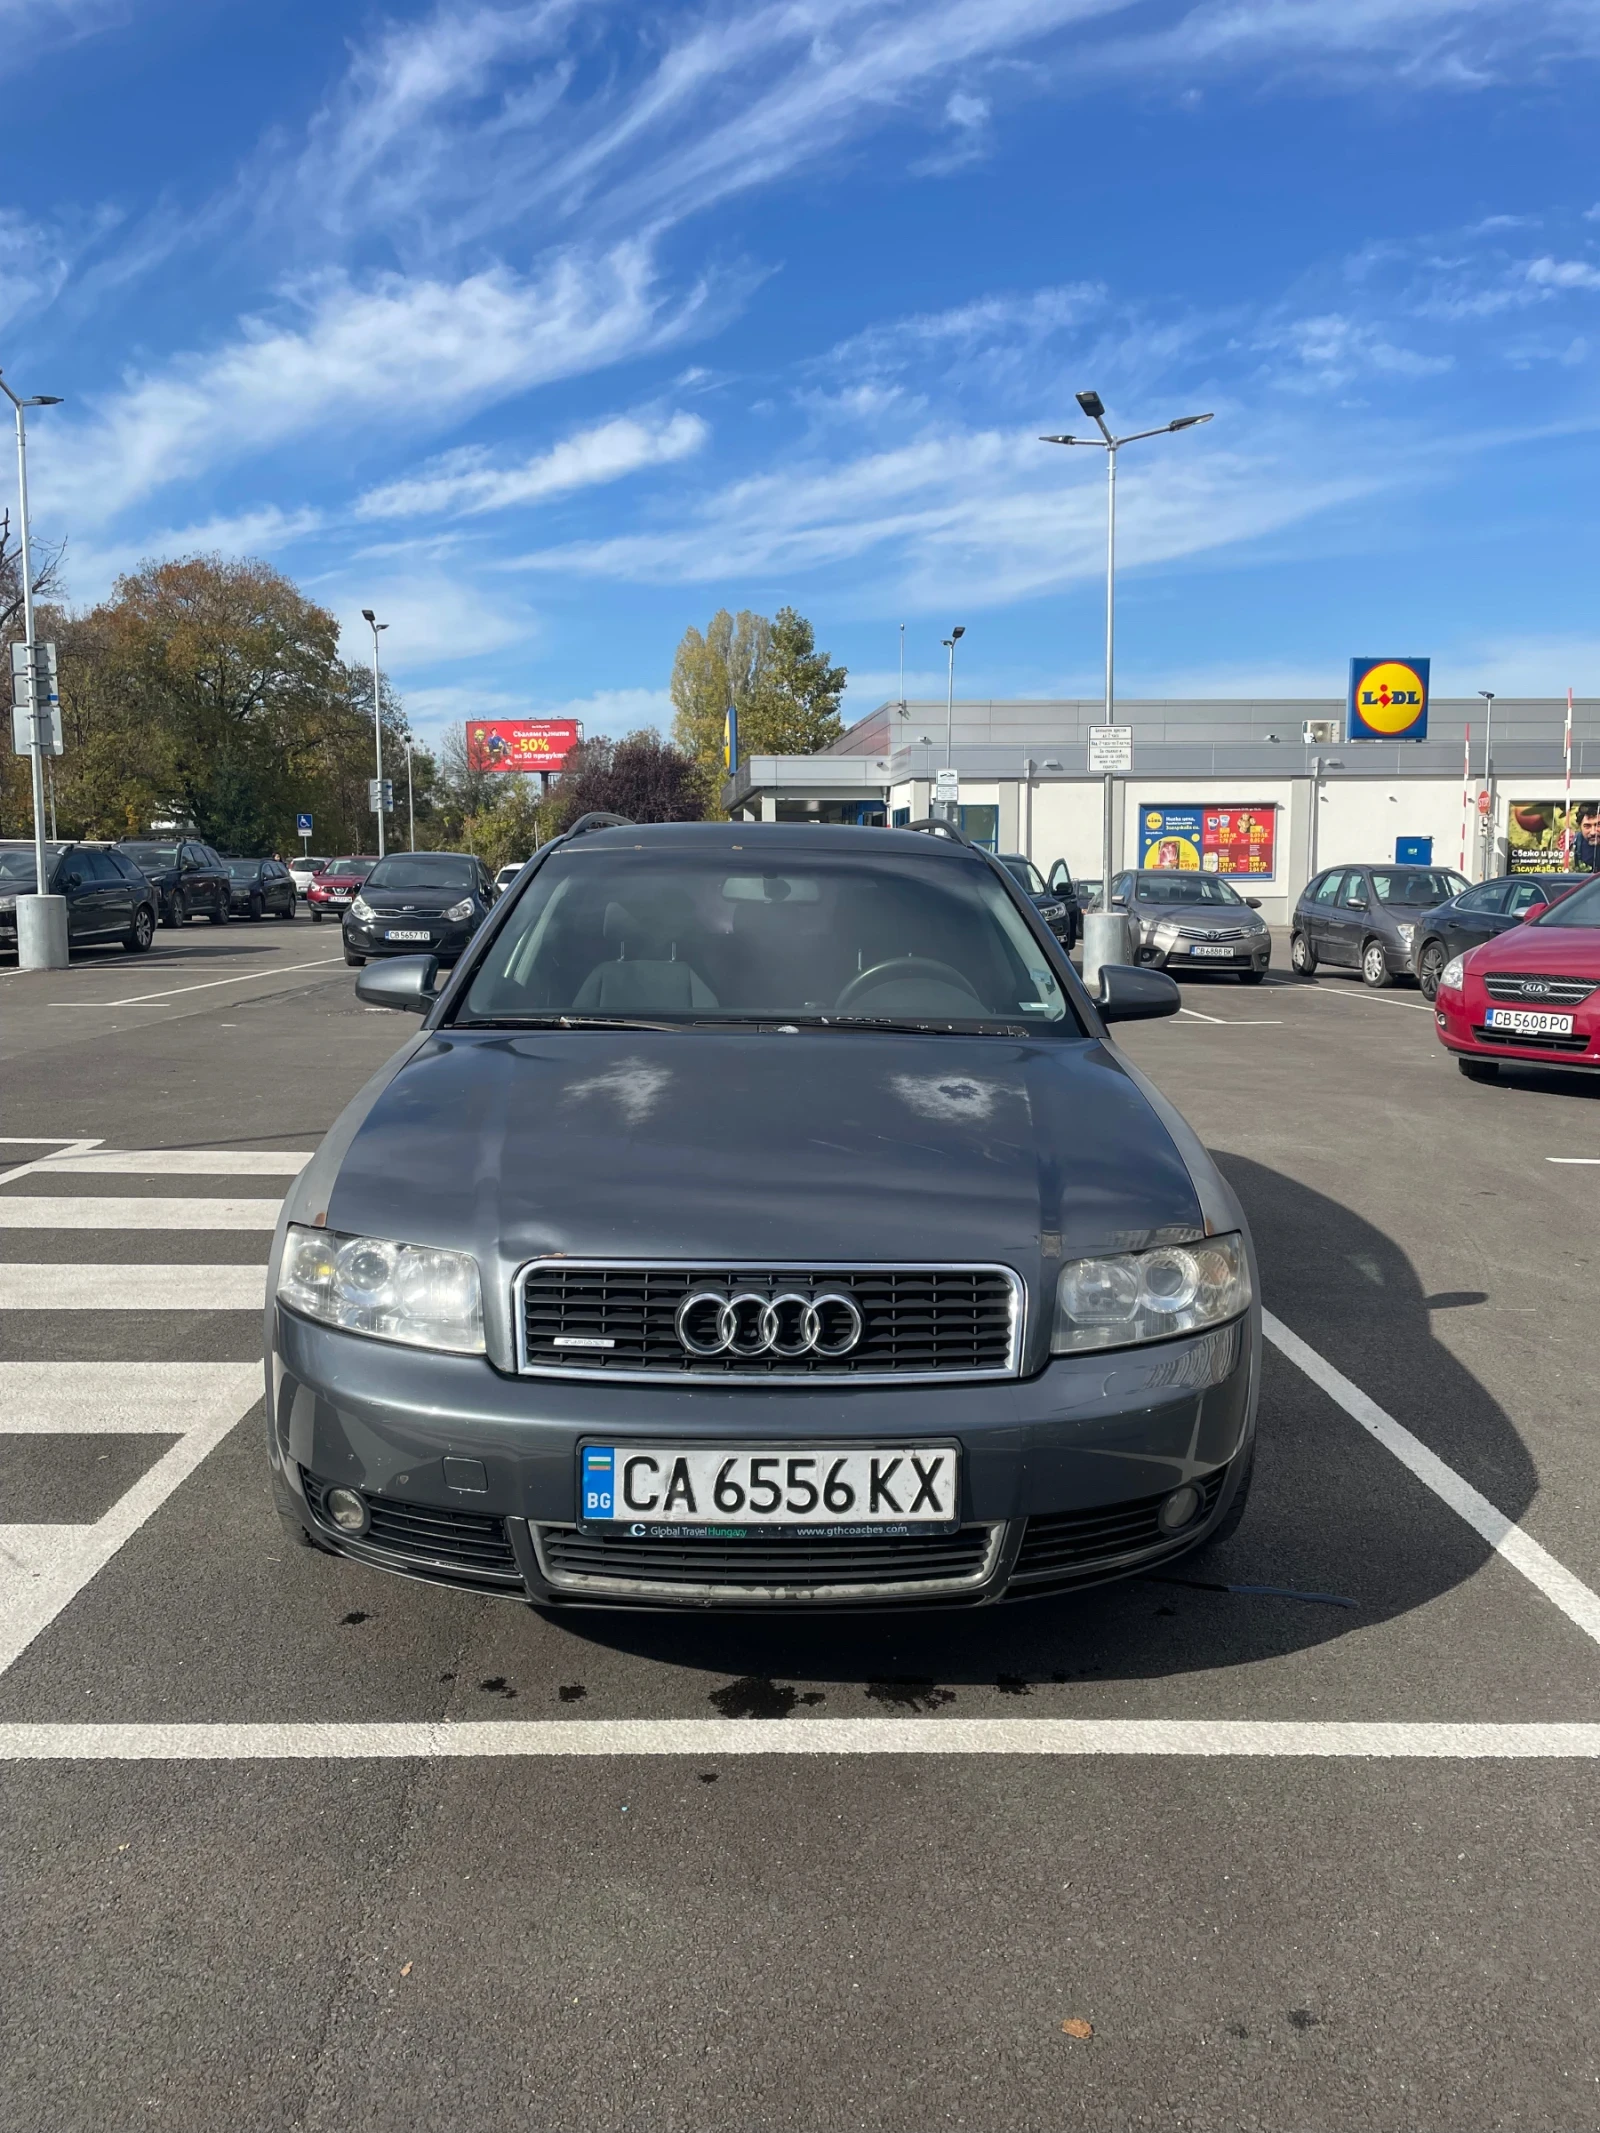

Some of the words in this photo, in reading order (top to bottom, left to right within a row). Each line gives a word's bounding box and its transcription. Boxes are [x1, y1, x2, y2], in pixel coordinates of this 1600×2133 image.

[514, 739, 549, 751] -50%
[400, 931, 418, 939] 5657
[1526, 983, 1543, 992] KIA
[1495, 1012, 1512, 1026] CB
[1513, 1013, 1547, 1029] 5608
[1549, 1016, 1569, 1031] PO
[623, 1455, 698, 1513] CA
[713, 1457, 856, 1514] 6556
[869, 1457, 945, 1513] KX
[587, 1492, 611, 1509] BG
[650, 1526, 681, 1536] Global
[796, 1524, 908, 1537] www.gthcoaches.com
